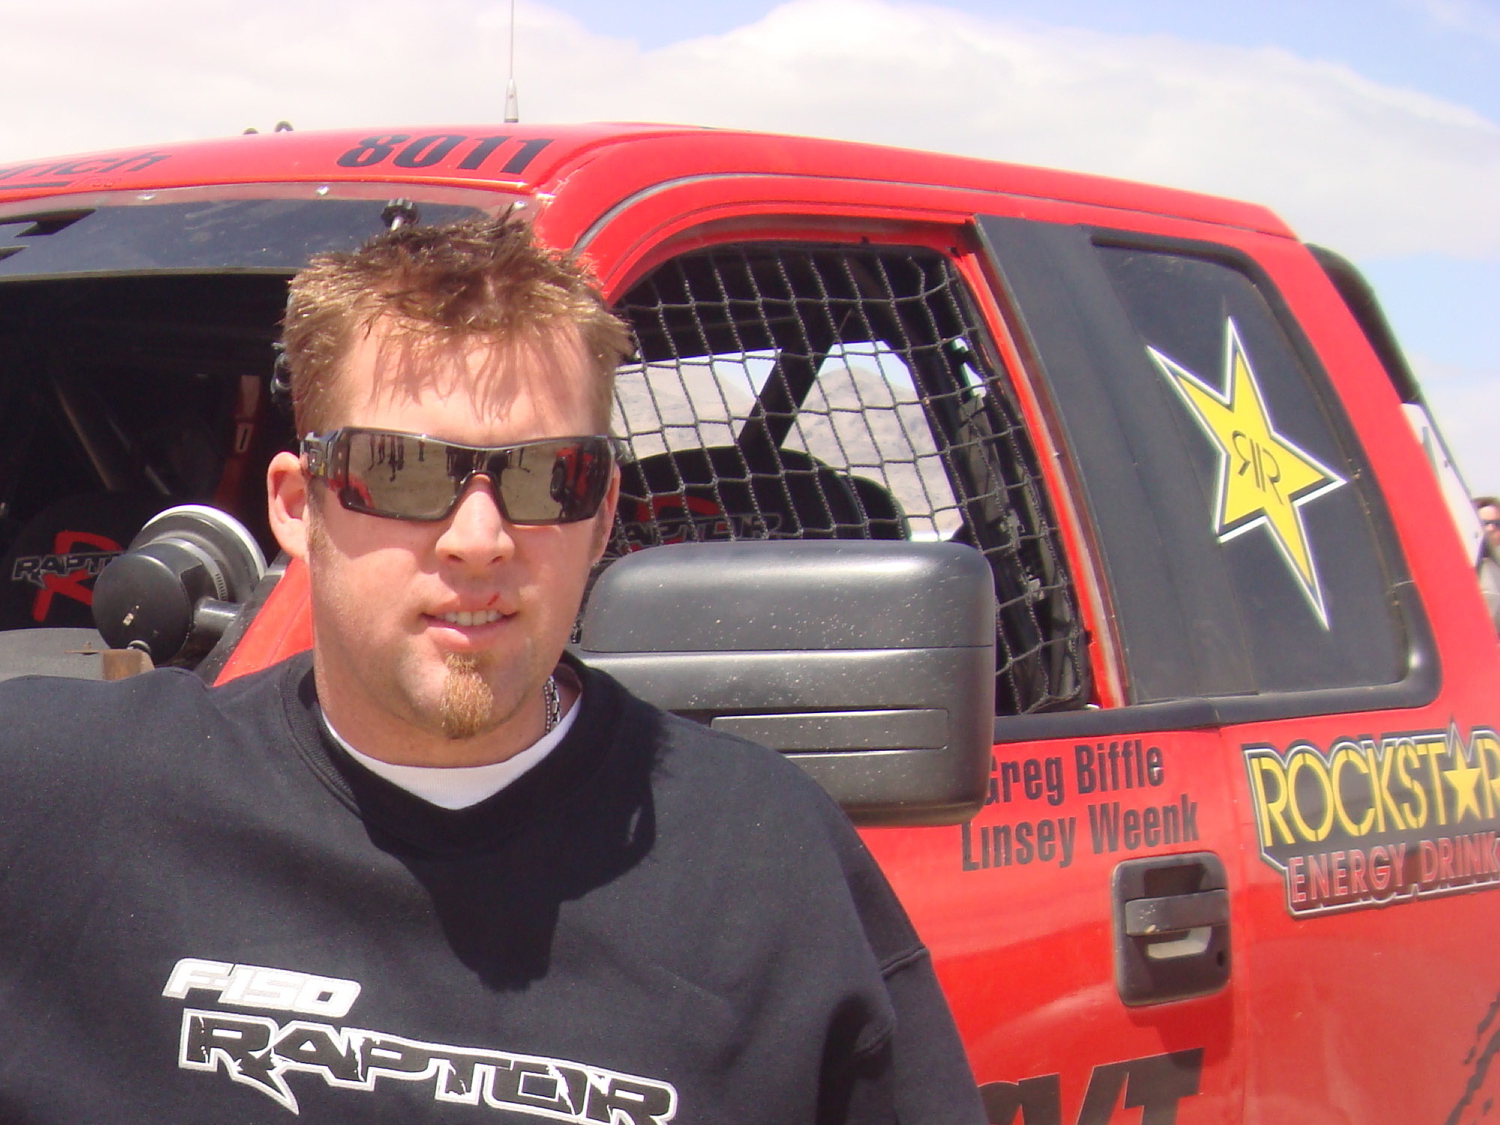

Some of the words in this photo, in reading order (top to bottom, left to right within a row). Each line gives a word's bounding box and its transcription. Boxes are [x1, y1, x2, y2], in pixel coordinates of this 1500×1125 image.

[336, 134, 555, 175] 8011
[11, 549, 114, 591] RAPT
[1073, 738, 1166, 796] Biffle
[961, 816, 1077, 872] Linsey
[1087, 793, 1200, 856] Weenk
[1288, 842, 1408, 904] ENERGY
[1419, 831, 1498, 883] DRINK
[162, 957, 362, 1018] F-150
